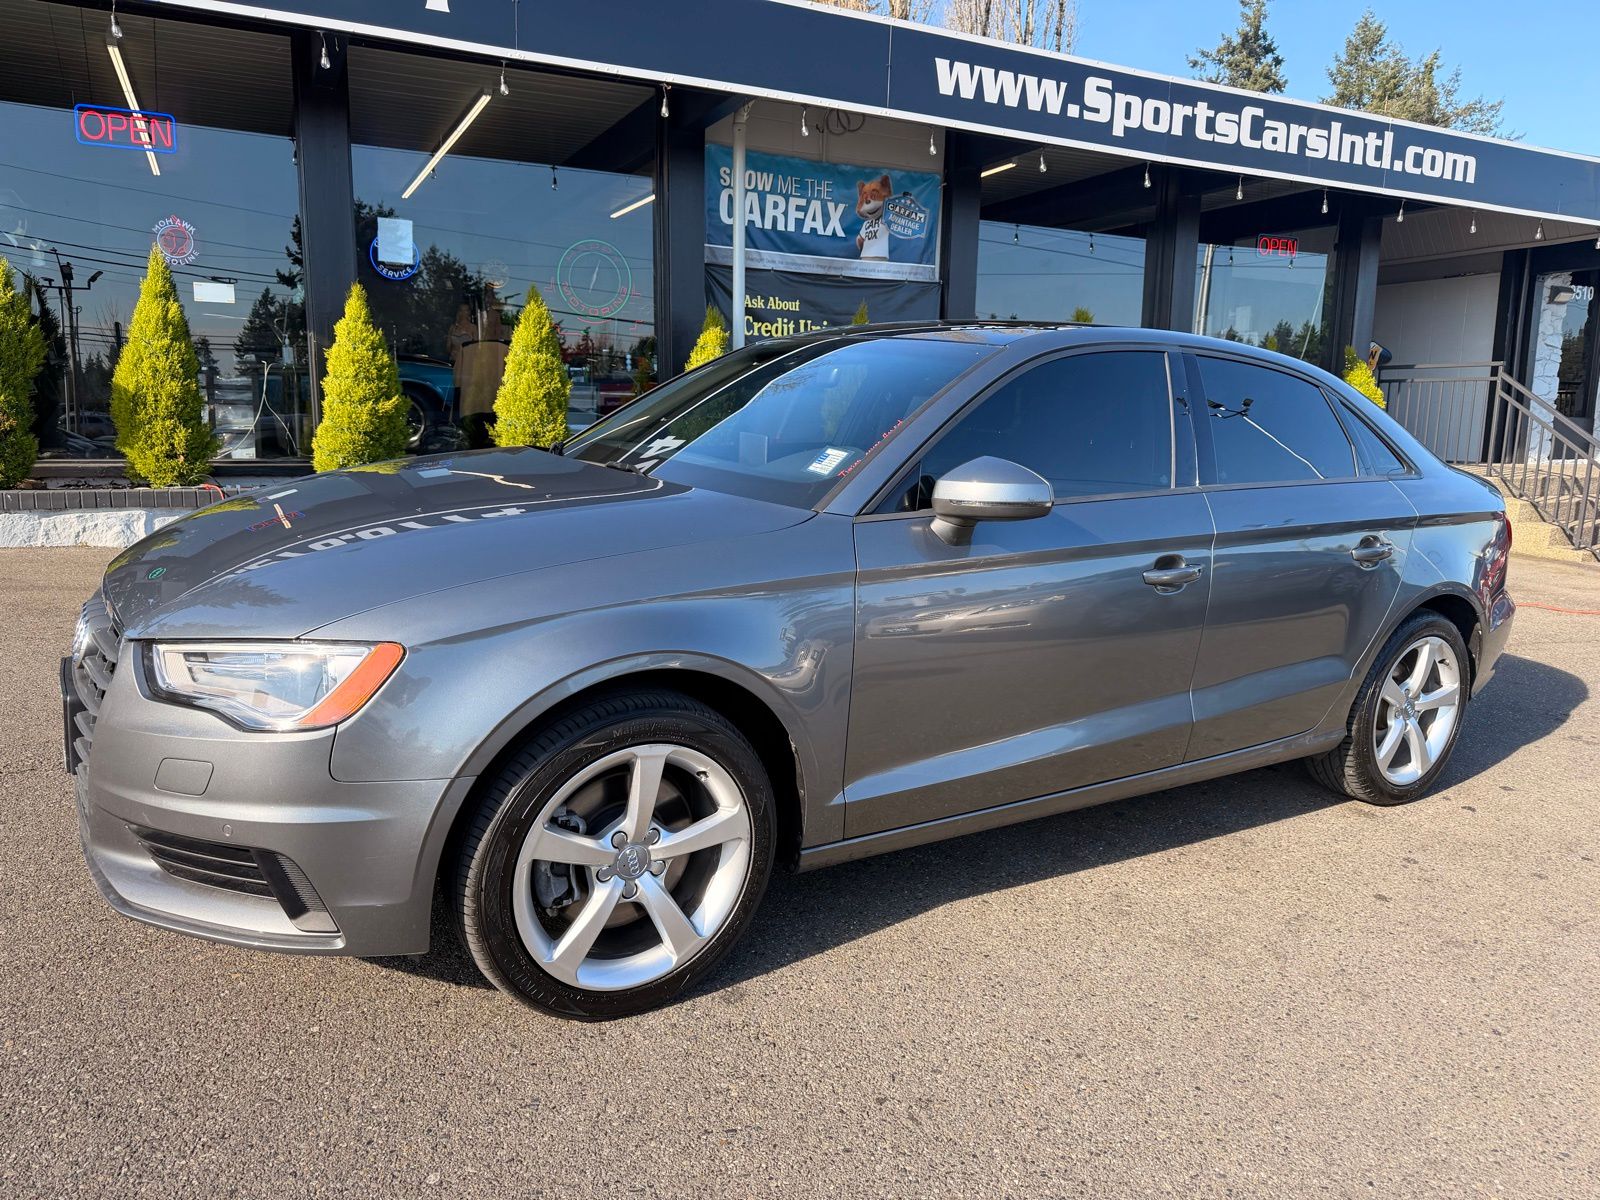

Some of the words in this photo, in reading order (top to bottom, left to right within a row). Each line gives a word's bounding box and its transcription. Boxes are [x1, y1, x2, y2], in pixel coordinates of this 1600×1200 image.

[80, 110, 172, 147] OPEN
[934, 56, 1478, 184] www.SportsCarsIntl.com
[720, 166, 773, 192] SOW
[777, 174, 801, 196] ME
[804, 178, 833, 200] THE
[720, 188, 847, 238] CARFAX
[887, 202, 926, 223] CARFAX
[888, 213, 920, 230] ADVANTAGE
[152, 217, 196, 235] MOHAWK
[864, 229, 879, 240] FOX
[890, 224, 913, 236] DEALER
[1260, 237, 1297, 257] OPEN
[378, 264, 413, 278] SERVICE
[744, 295, 765, 309] Ask
[767, 296, 800, 311] About
[744, 315, 795, 338] Credit
